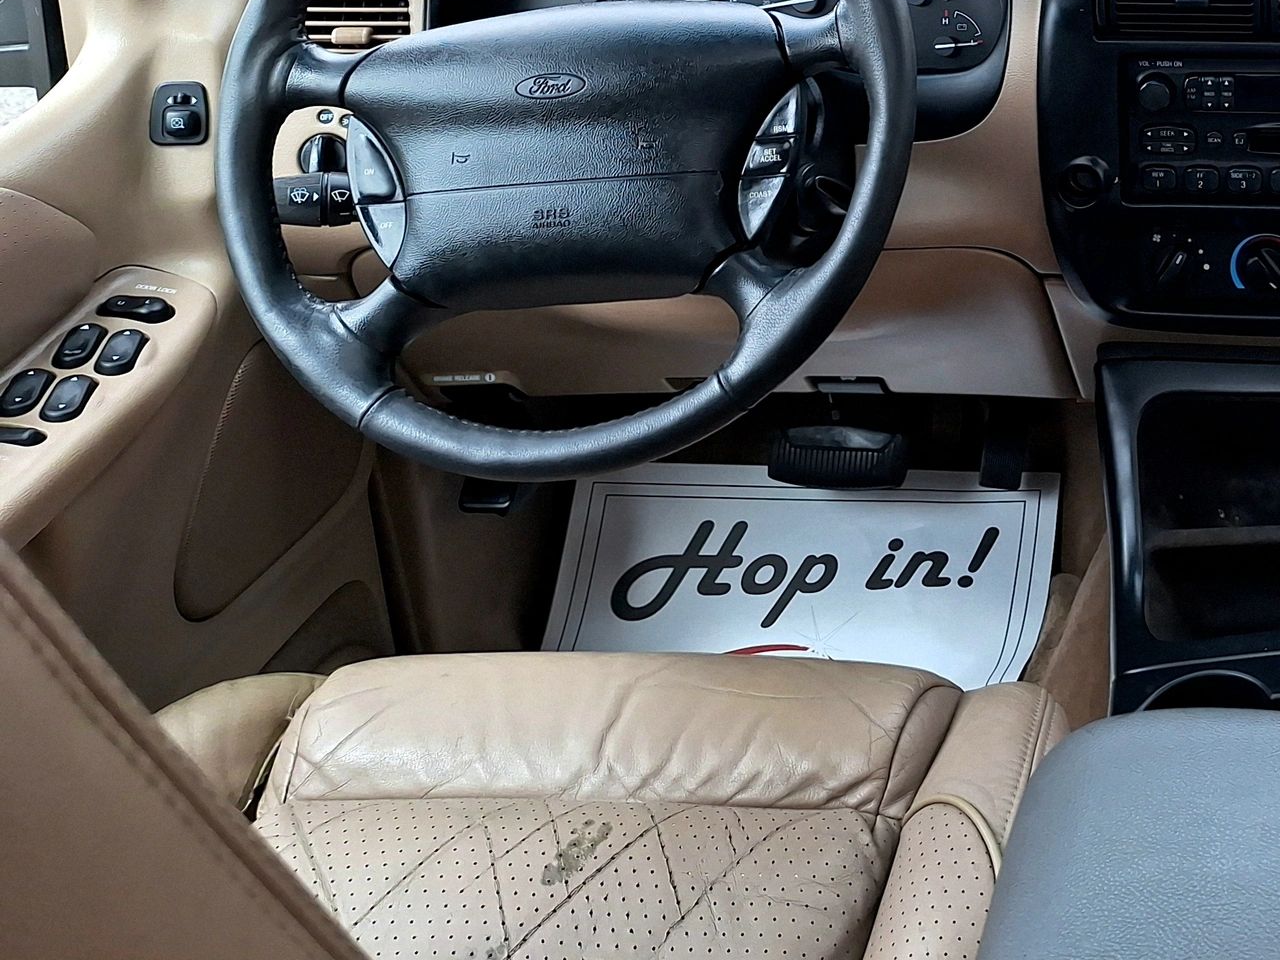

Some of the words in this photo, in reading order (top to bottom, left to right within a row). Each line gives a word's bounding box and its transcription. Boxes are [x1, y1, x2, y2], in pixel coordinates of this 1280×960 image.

[942, 17, 949, 25] H
[529, 75, 572, 95] Ford
[319, 113, 334, 121] OFF
[764, 148, 777, 156] SET
[760, 154, 782, 163] ACCEL
[1197, 181, 1203, 189] 2
[1240, 181, 1246, 189] 3
[749, 190, 772, 198] COAST
[532, 209, 571, 220] SRS
[610, 520, 839, 629] Hop
[865, 526, 1000, 591] in!
